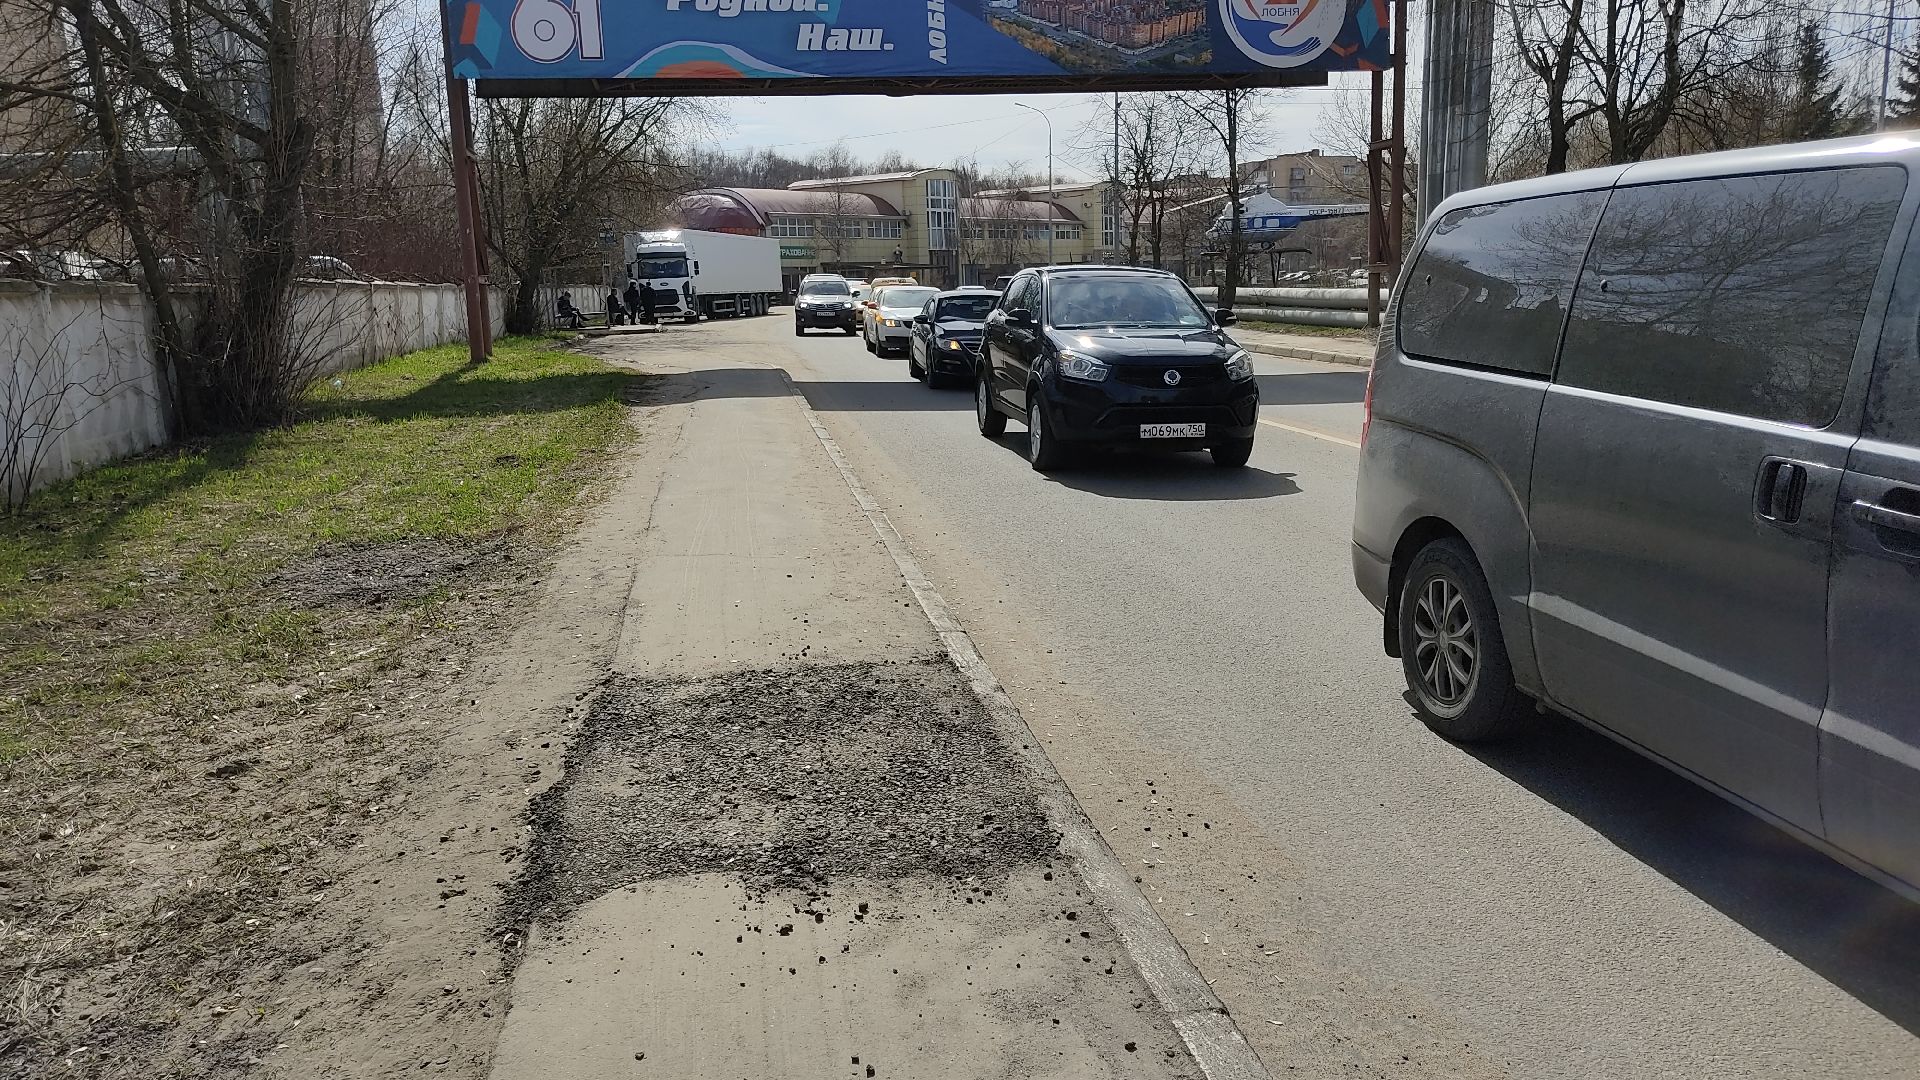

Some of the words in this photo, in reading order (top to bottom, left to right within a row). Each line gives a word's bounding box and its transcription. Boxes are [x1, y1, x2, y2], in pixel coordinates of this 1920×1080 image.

[1261, 7, 1300, 17] ЛОБНЯ
[510, 0, 604, 63] 61
[797, 23, 894, 51] Наш.
[1143, 425, 1186, 437] М069МК
[1187, 424, 1204, 433] 750
